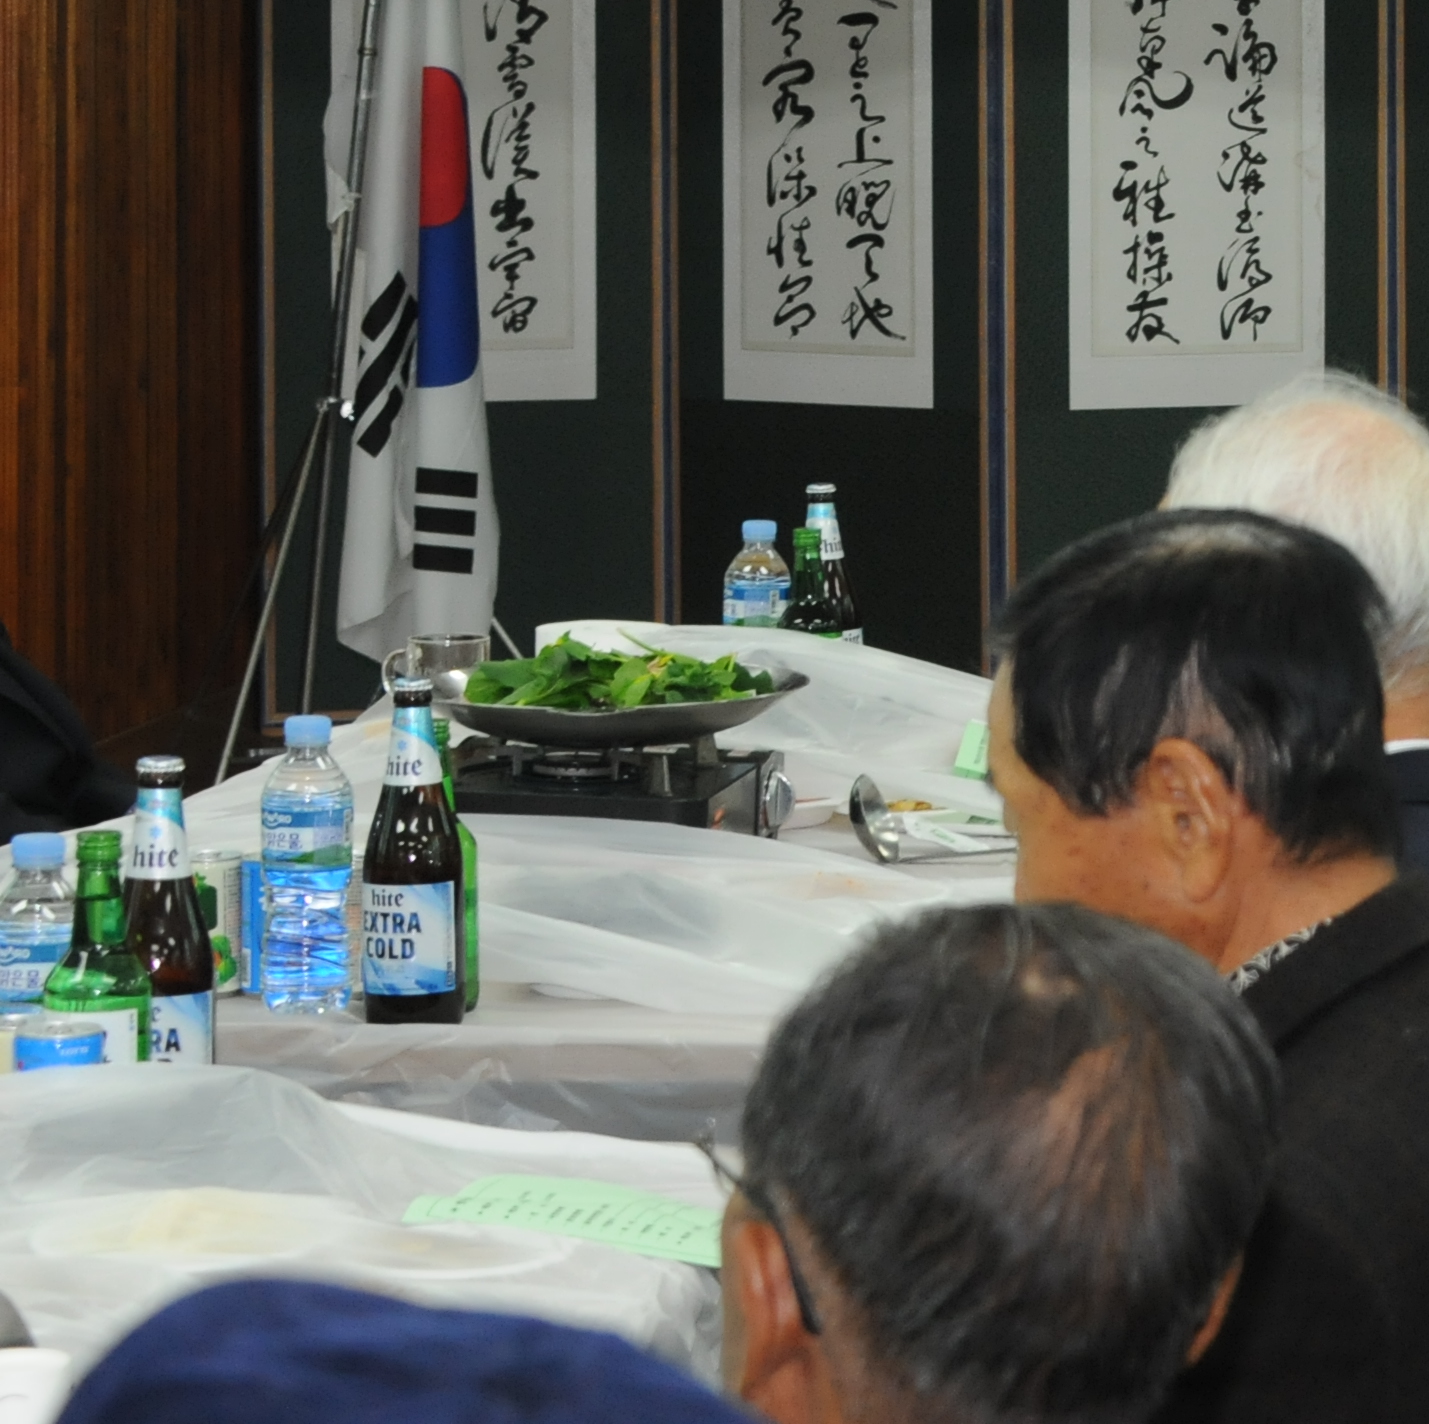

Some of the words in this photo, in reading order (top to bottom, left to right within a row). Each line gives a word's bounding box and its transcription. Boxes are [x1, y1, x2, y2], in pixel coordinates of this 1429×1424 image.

[385, 754, 423, 777] hite
[132, 844, 180, 869] hite
[371, 888, 405, 908] hite
[363, 911, 423, 935] EXTRA
[366, 937, 416, 961] COLD
